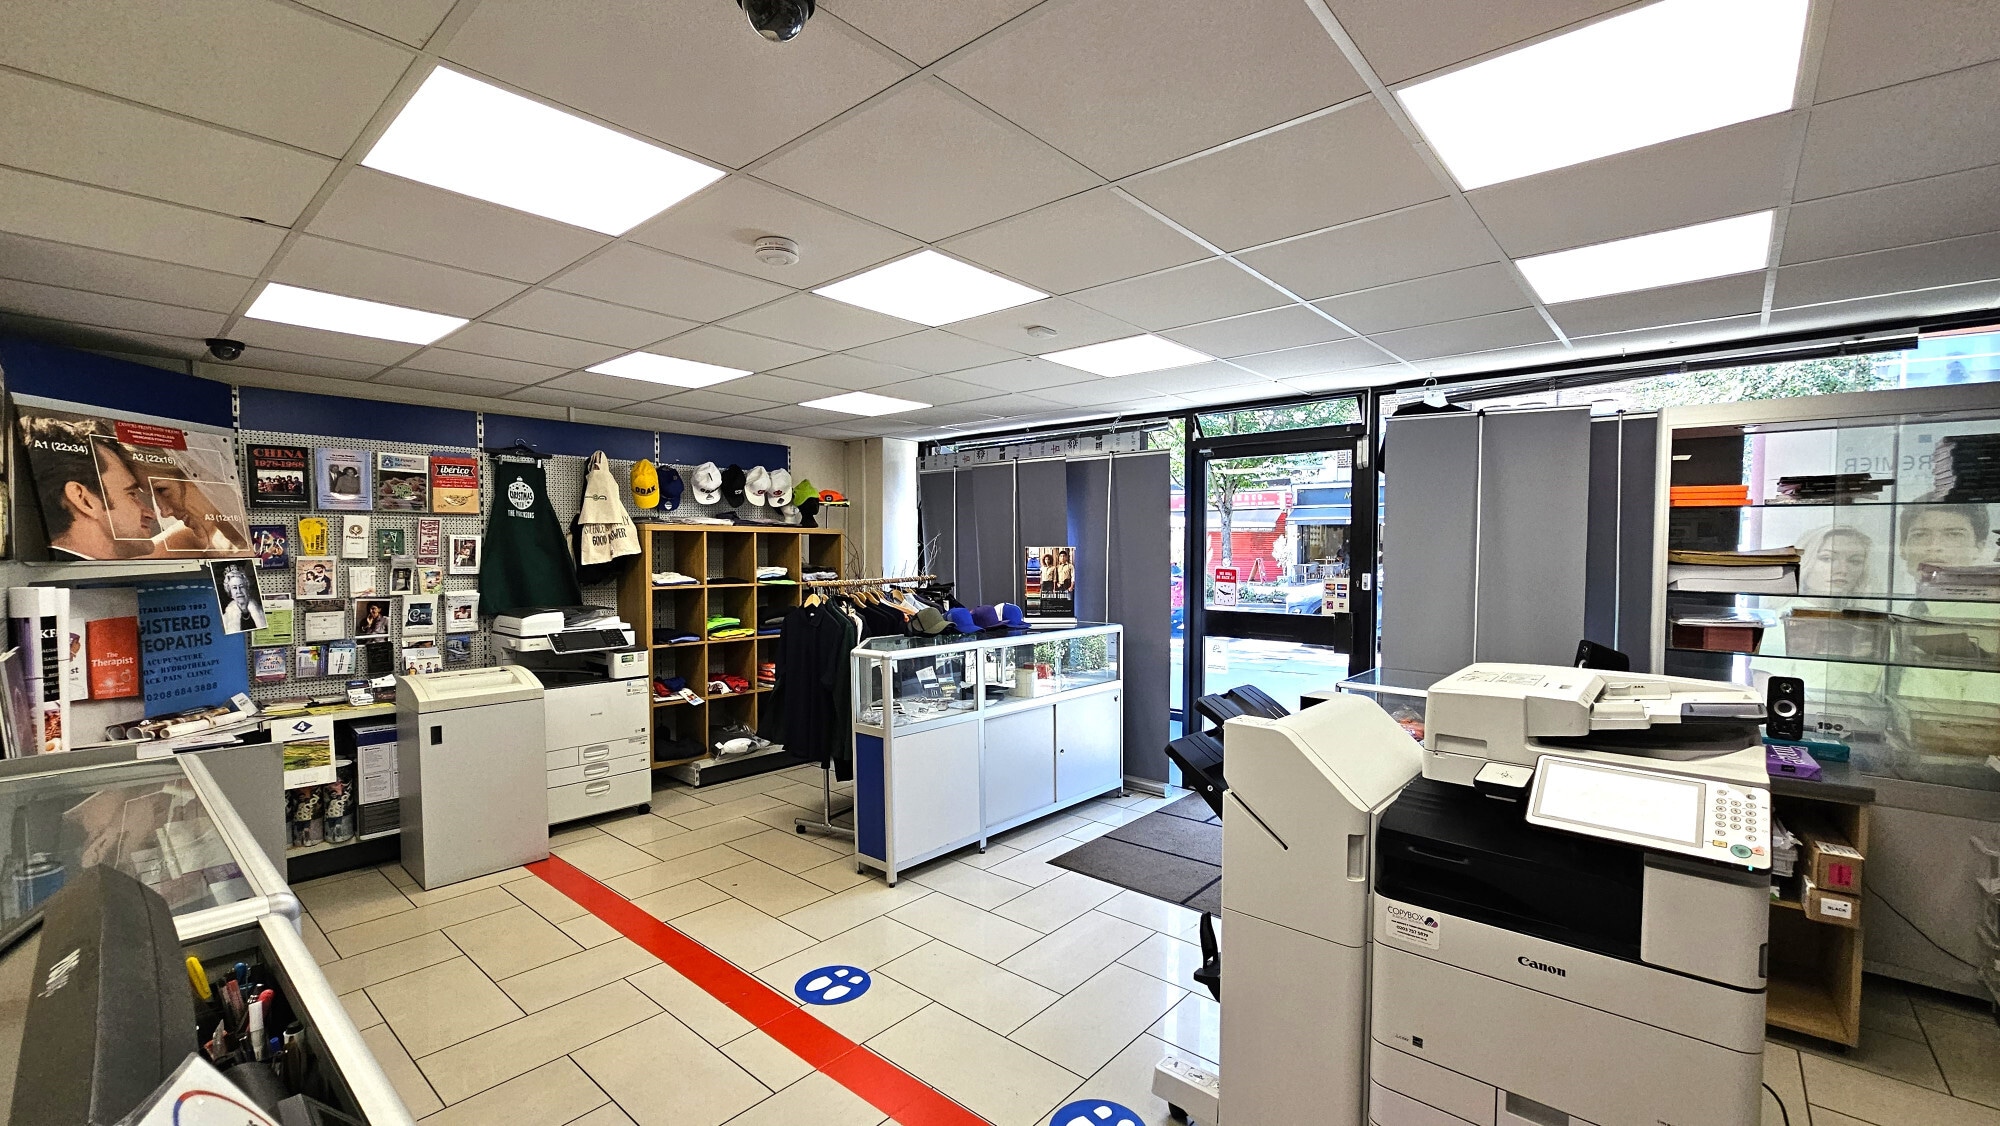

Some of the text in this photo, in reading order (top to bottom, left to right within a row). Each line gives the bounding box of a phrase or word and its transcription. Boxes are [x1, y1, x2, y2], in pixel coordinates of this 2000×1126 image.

[34, 439, 88, 455] A1 (22x34)
[253, 448, 304, 459] CHINA
[132, 453, 176, 465] A2 (22x16)
[440, 465, 470, 475] ibérico
[204, 513, 215, 521] A3
[592, 534, 608, 546] GOOD
[139, 604, 187, 615] STABLISHED
[139, 614, 211, 635] GISTERED
[141, 632, 213, 653] EOPATHS
[91, 656, 134, 667] Therapist
[147, 652, 204, 667] ACUPUNCTURE
[142, 659, 220, 677] ON HYDROTHERAPY
[144, 669, 214, 686] ACK PAIN CLINIC
[146, 690, 172, 702] 0208
[174, 686, 193, 697] 684
[1387, 905, 1425, 921] COPYBOX
[1826, 905, 1848, 913] BLACK
[1517, 956, 1566, 978] Canon
